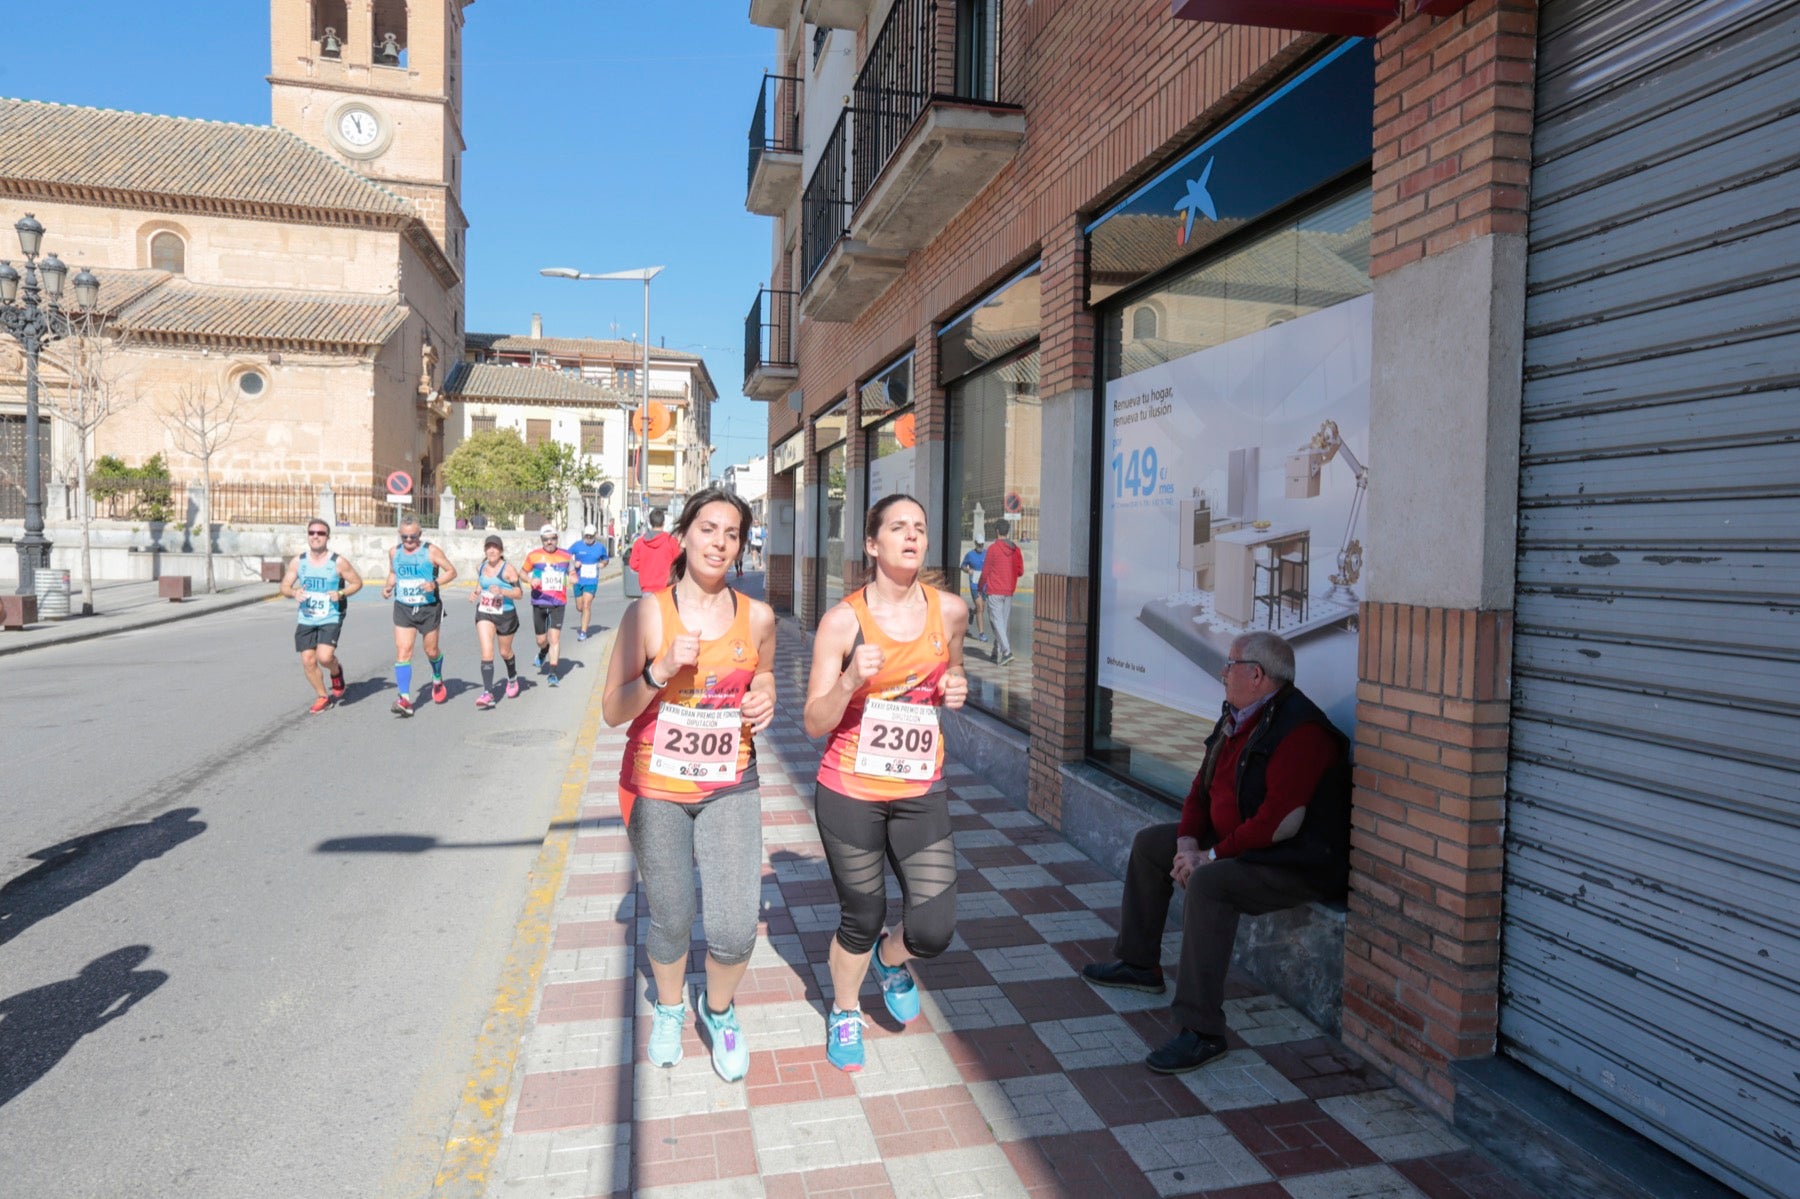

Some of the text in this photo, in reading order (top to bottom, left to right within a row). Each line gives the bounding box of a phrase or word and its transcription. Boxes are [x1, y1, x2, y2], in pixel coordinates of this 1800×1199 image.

[1113, 387, 1174, 411] Renueva tu hogar,
[1112, 412, 1139, 428] renueva
[1140, 409, 1148, 421] tu
[1112, 446, 1158, 498] 149
[1159, 483, 1175, 494] mes
[681, 708, 696, 718] GRAN
[696, 711, 716, 719] PREMIO
[664, 728, 733, 756] 2308
[870, 724, 933, 753] 2309
